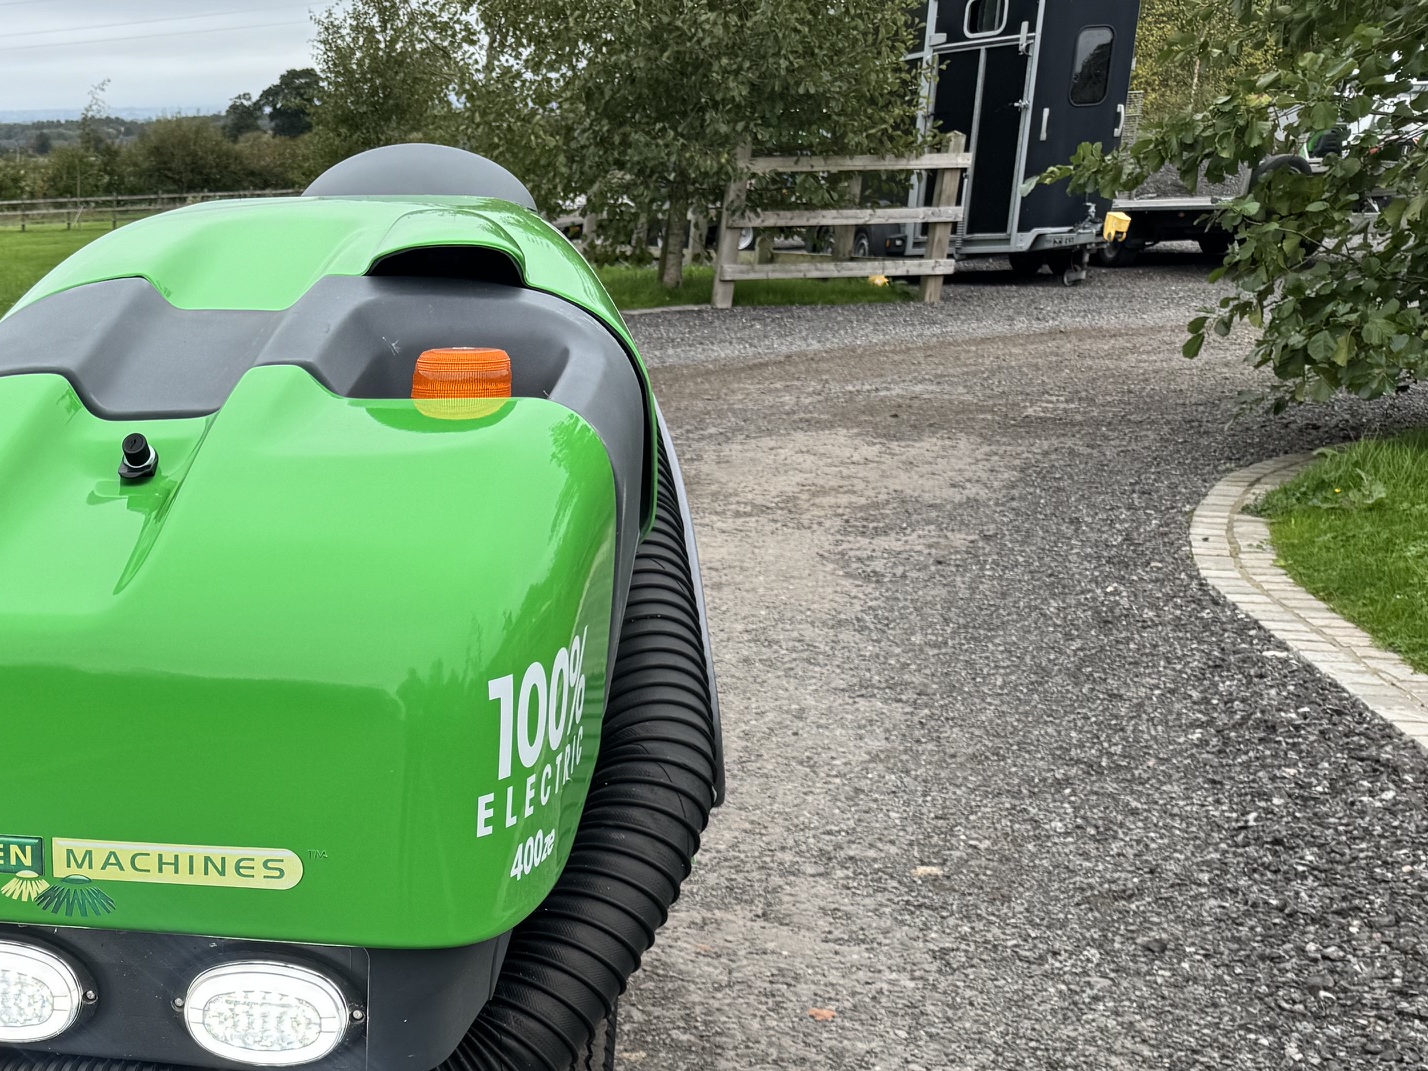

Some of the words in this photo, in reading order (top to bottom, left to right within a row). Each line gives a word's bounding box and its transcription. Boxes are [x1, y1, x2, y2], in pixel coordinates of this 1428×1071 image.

[487, 624, 589, 781] 100%
[476, 725, 584, 838] ELECTRIC
[65, 847, 287, 880] MACHINES
[510, 828, 556, 881] 400ze
